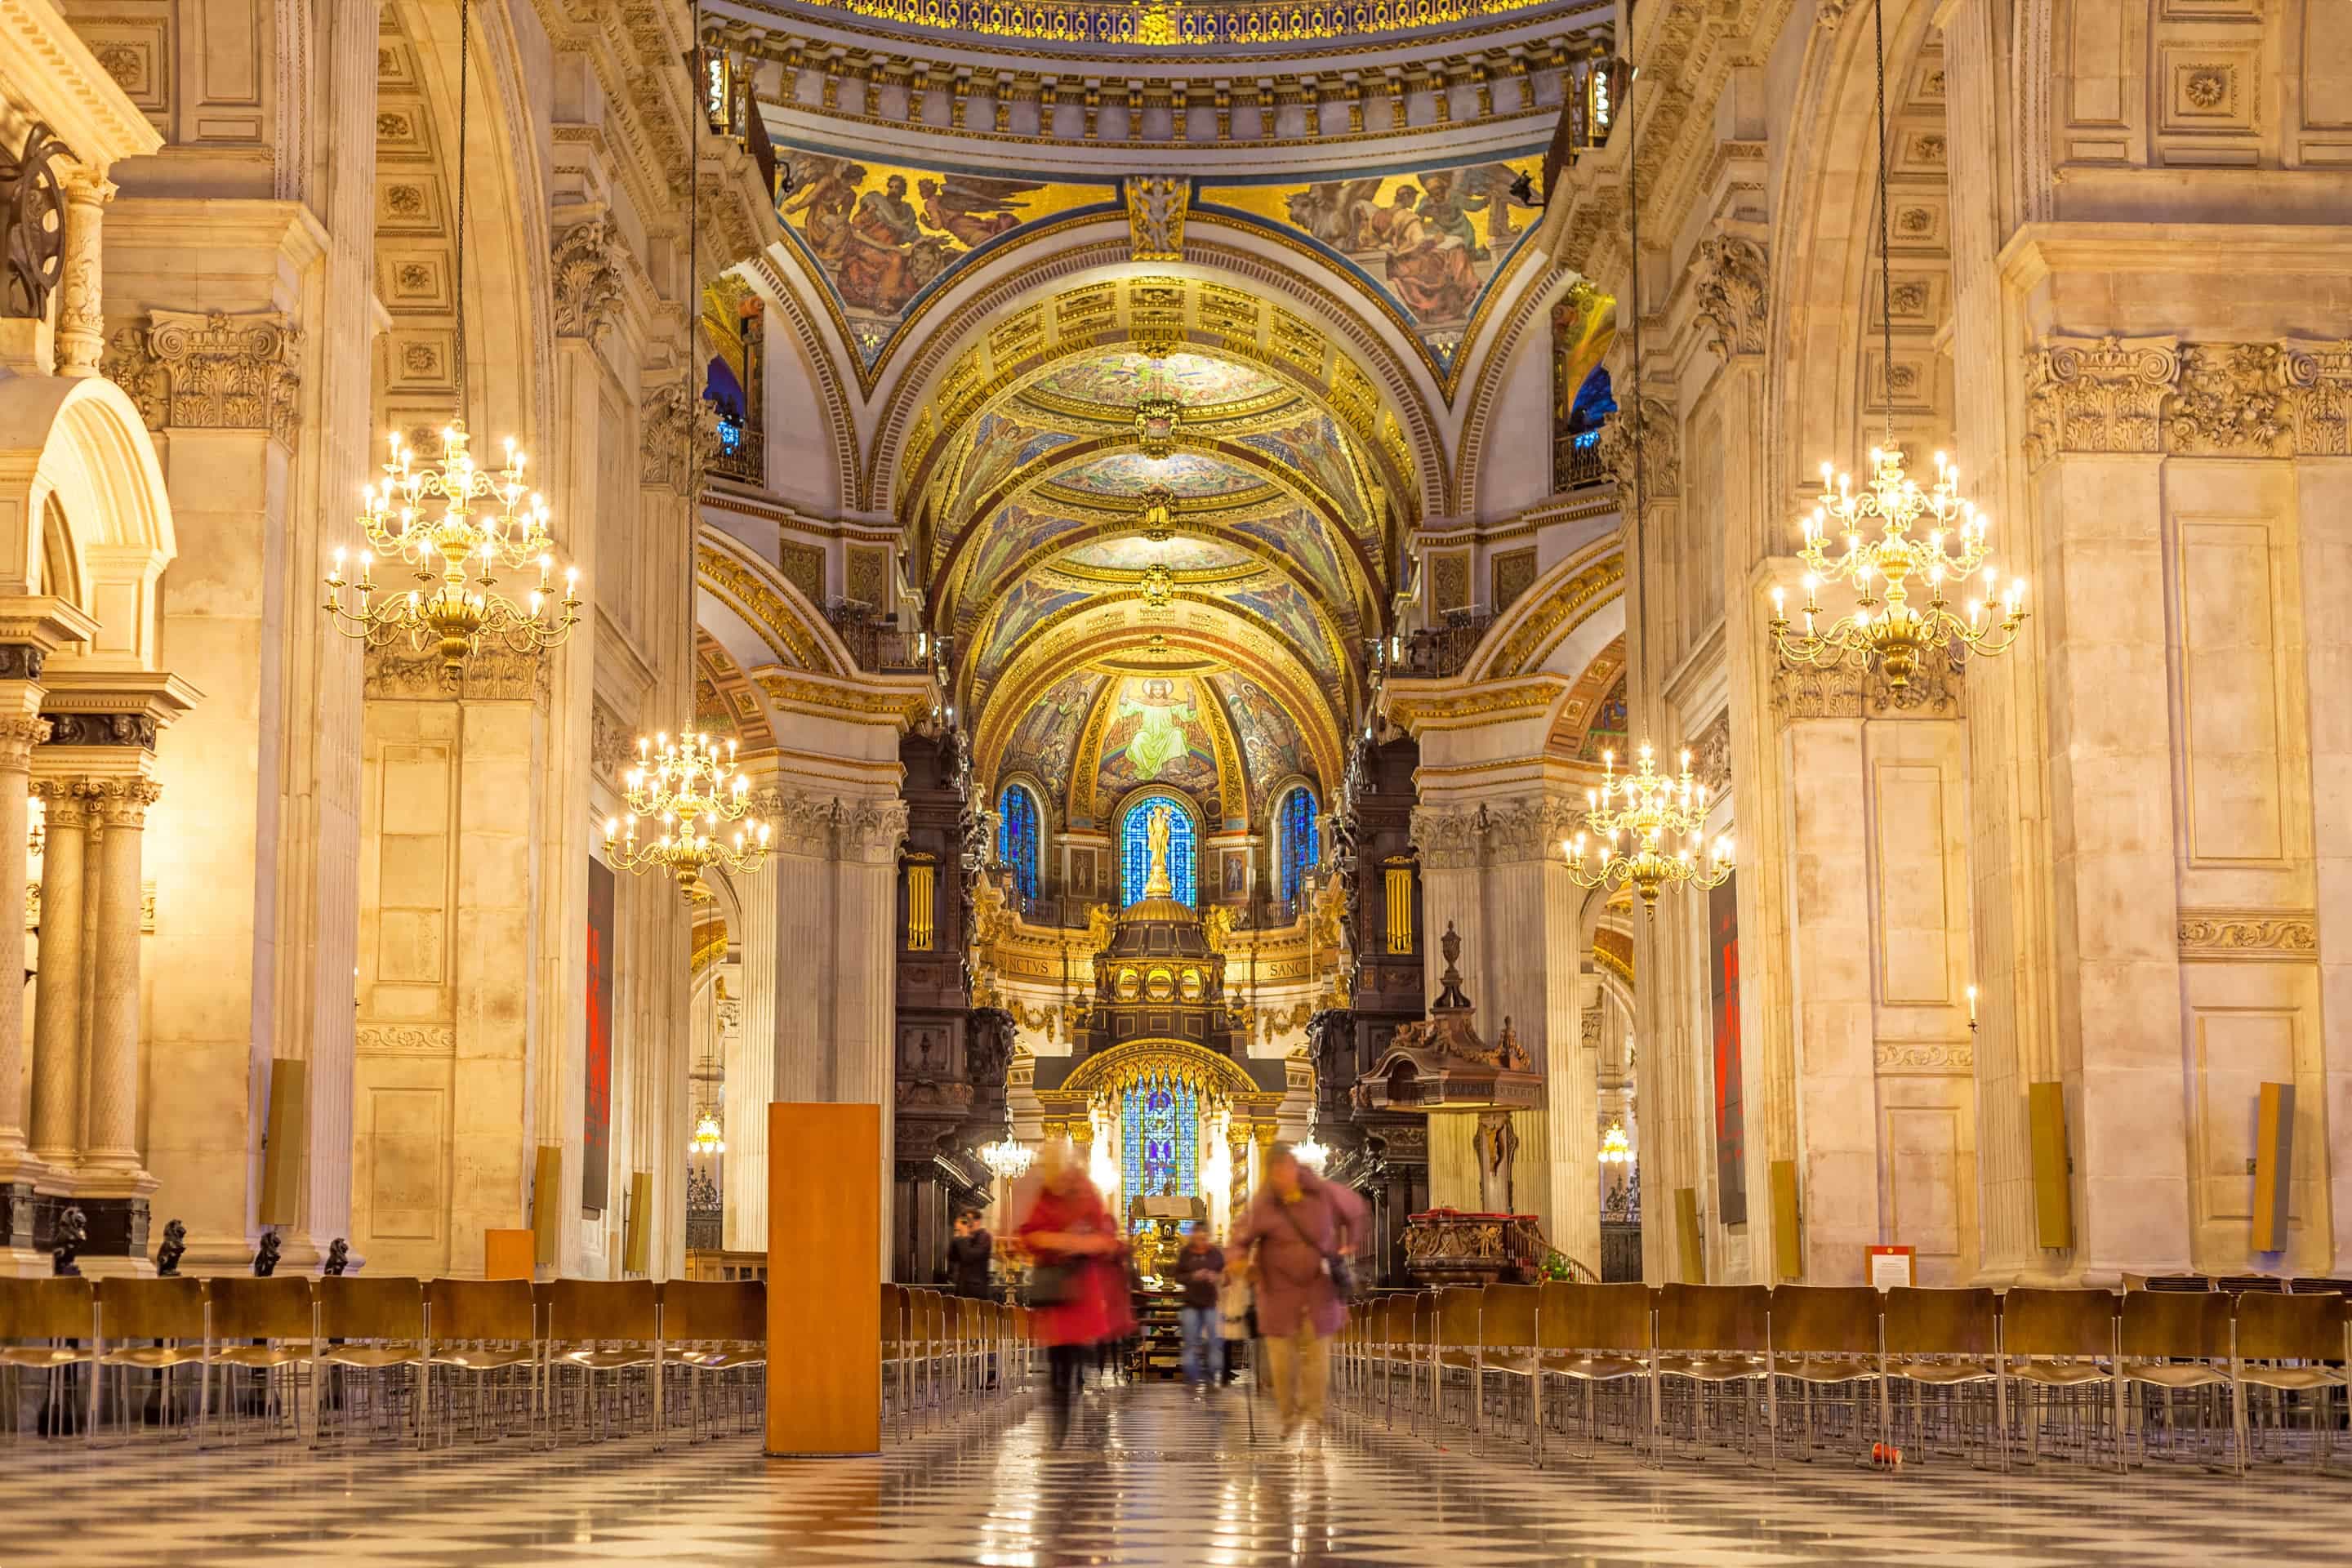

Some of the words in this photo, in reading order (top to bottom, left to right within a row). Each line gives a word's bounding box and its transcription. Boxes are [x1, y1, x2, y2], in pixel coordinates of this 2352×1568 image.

[943, 372, 1013, 436] BENEDICITE
[1045, 338, 1094, 361] OMNIA
[1131, 328, 1184, 341] OPERA
[1221, 339, 1272, 365] DOMINI
[1325, 392, 1371, 439] DOMINO
[1001, 461, 1047, 495] OMNES
[1270, 463, 1317, 503] PECORA
[968, 596, 997, 633] OMNIA
[1267, 550, 1281, 564] IN
